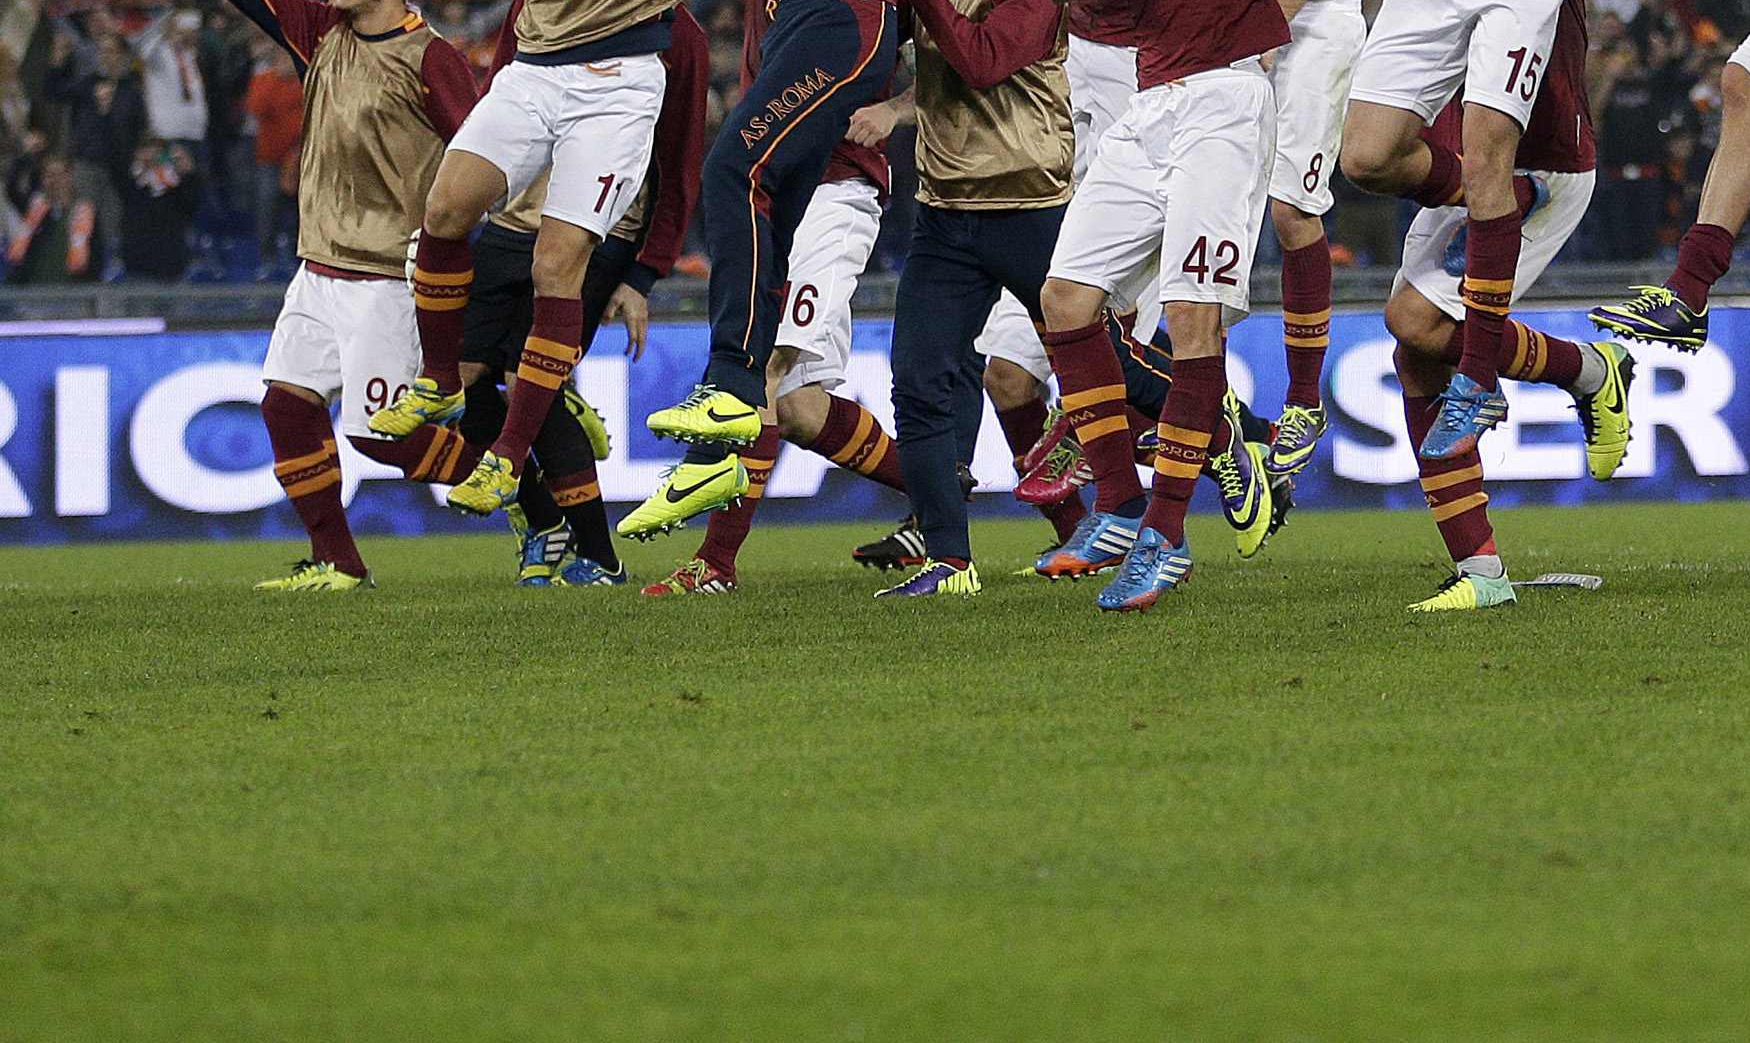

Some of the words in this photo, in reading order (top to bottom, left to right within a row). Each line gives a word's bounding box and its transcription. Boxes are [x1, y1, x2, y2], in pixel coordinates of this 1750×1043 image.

[1504, 46, 1543, 102] 15
[1303, 152, 1323, 194] 8
[1182, 236, 1240, 286] 42
